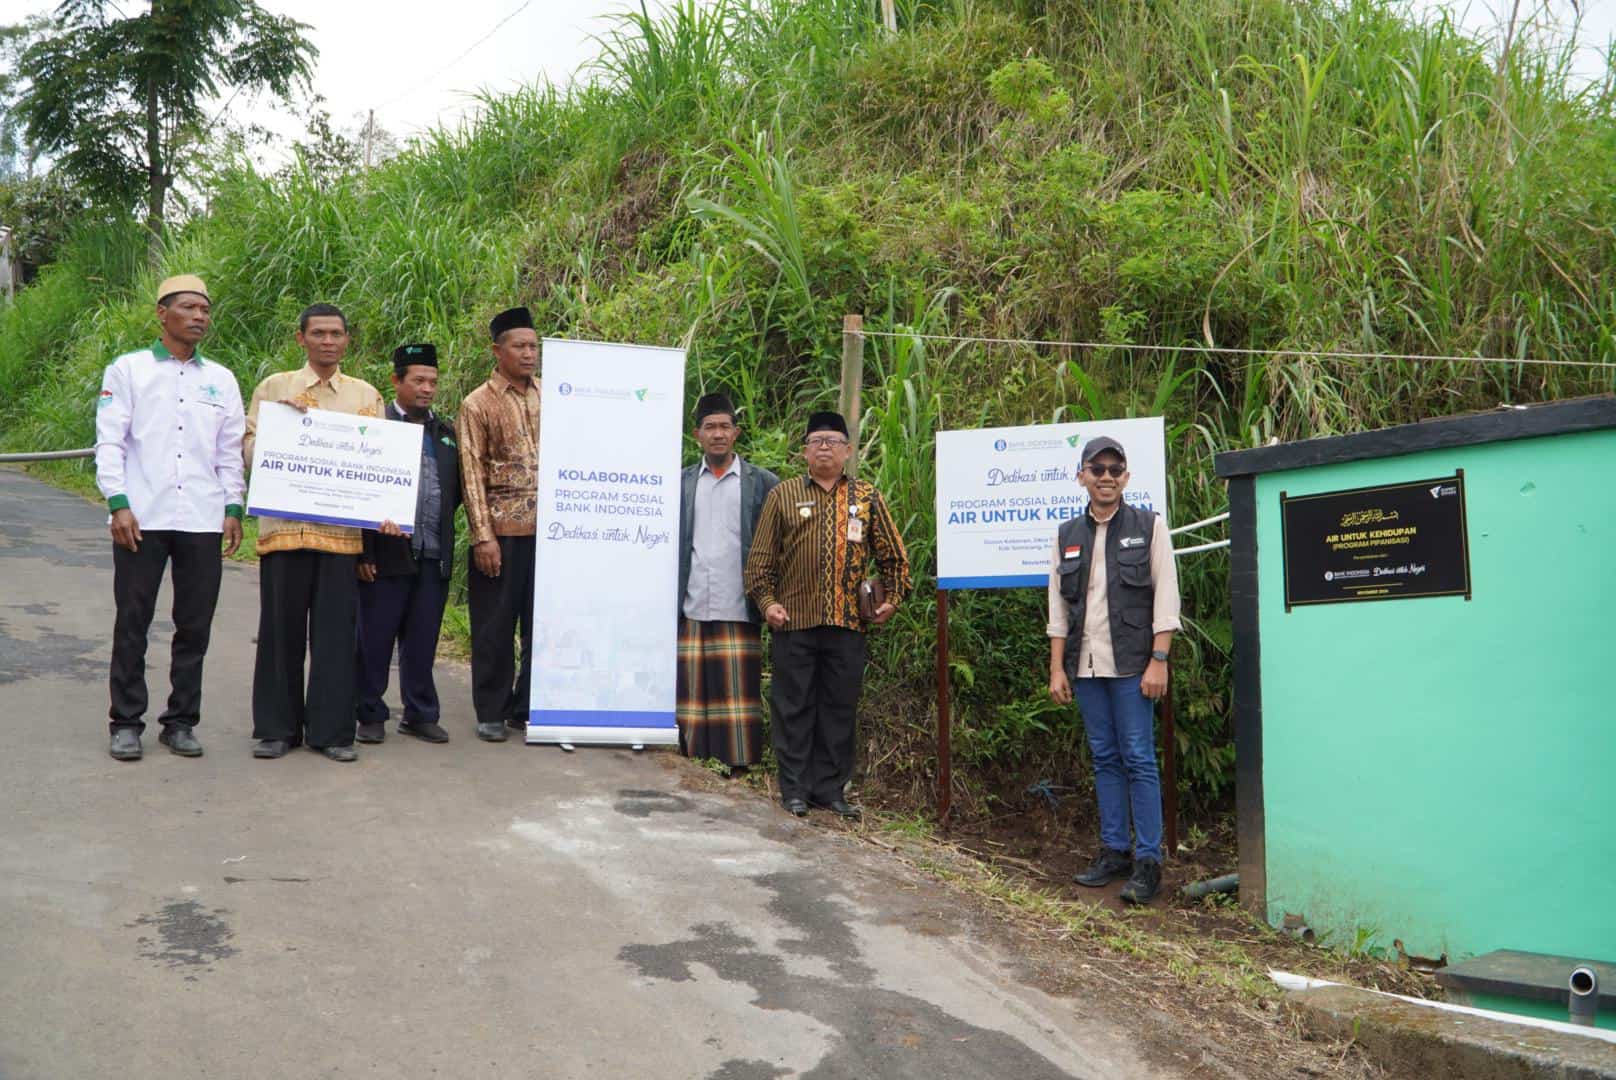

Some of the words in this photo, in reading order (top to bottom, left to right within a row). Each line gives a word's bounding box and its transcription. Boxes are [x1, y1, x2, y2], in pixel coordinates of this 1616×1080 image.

[263, 449, 308, 463] PROGRAM
[310, 456, 338, 468] SOSIAL
[366, 464, 412, 477] INDONESIA
[260, 458, 284, 471] AIR
[287, 462, 332, 477] UNTUK
[336, 468, 413, 487] KEHIDUPAN
[557, 468, 663, 486] KOLABORAKSI
[986, 466, 1038, 486] Dedikasi
[1040, 465, 1069, 482] untuk
[554, 488, 619, 501] PROGRAM
[622, 492, 665, 505] SOSIAL
[950, 498, 1006, 511] PROGRAM
[1008, 495, 1047, 507] SOSIAL
[1050, 494, 1083, 506] BANK
[555, 501, 591, 513] BANK
[595, 503, 664, 518] INDONESIA
[948, 510, 977, 525] AIR
[982, 507, 1041, 524] UNTUK
[546, 521, 600, 541] Dedikasi
[602, 527, 631, 542] untuk
[632, 523, 670, 549] Negeri
[1326, 534, 1339, 543] AIR
[1341, 531, 1368, 542] UNTUK
[1369, 526, 1417, 539] KEHIDUPAN
